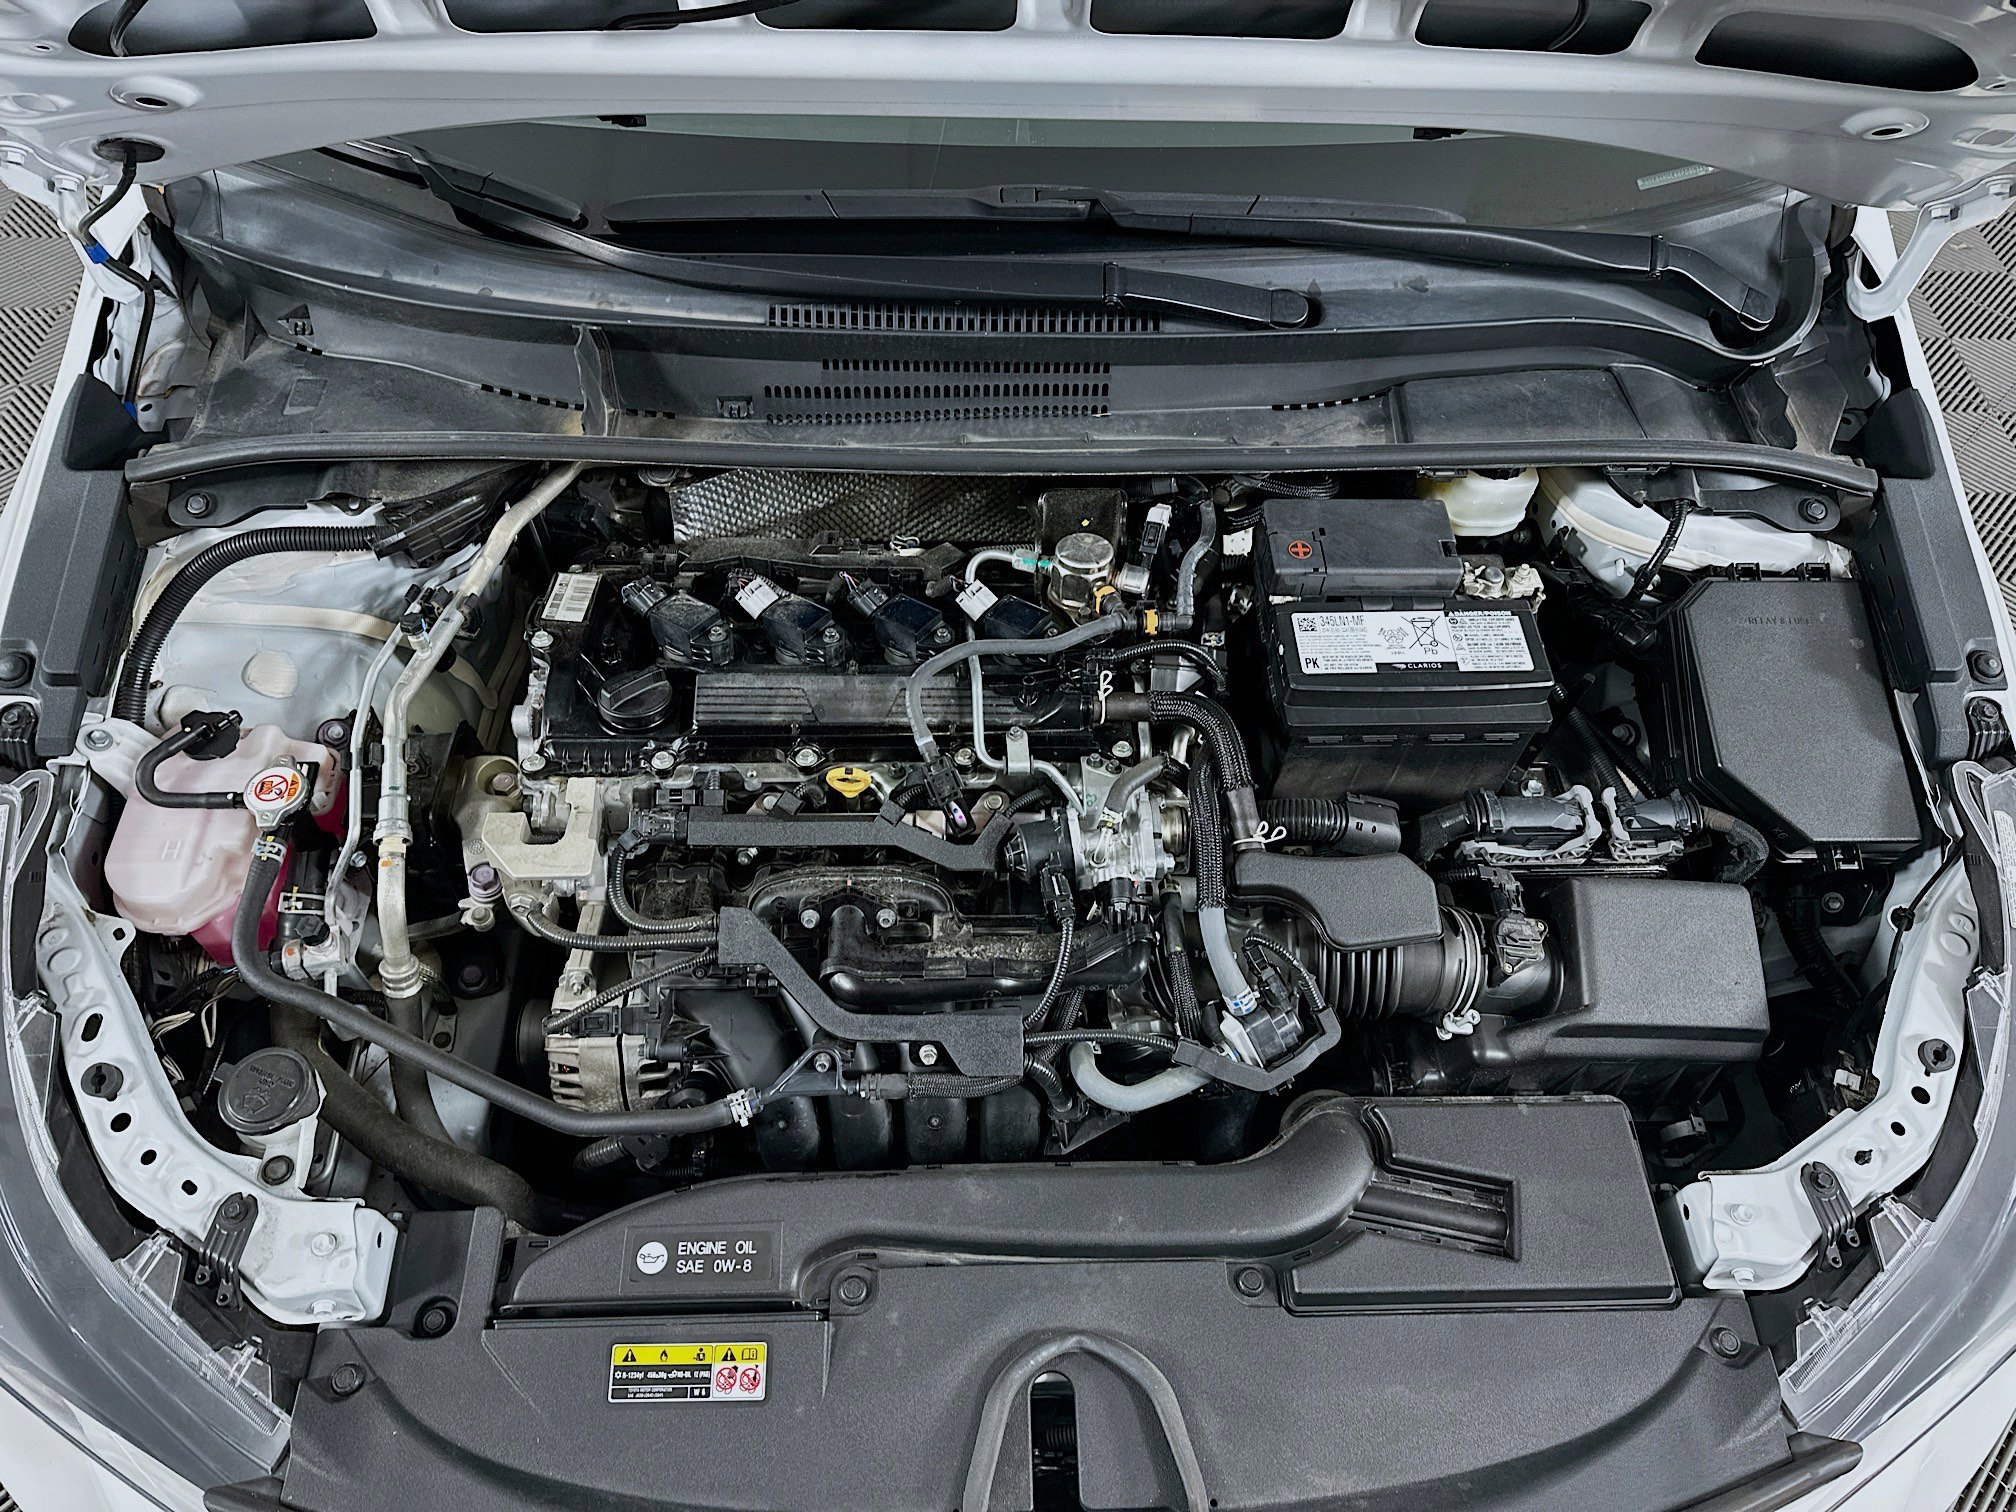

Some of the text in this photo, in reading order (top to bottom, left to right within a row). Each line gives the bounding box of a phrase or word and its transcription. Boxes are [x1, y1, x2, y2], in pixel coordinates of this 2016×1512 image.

[1305, 657, 1320, 669] PK
[677, 1240, 758, 1256] ENGINE OIL
[676, 1258, 752, 1274] SAE 0W-8
